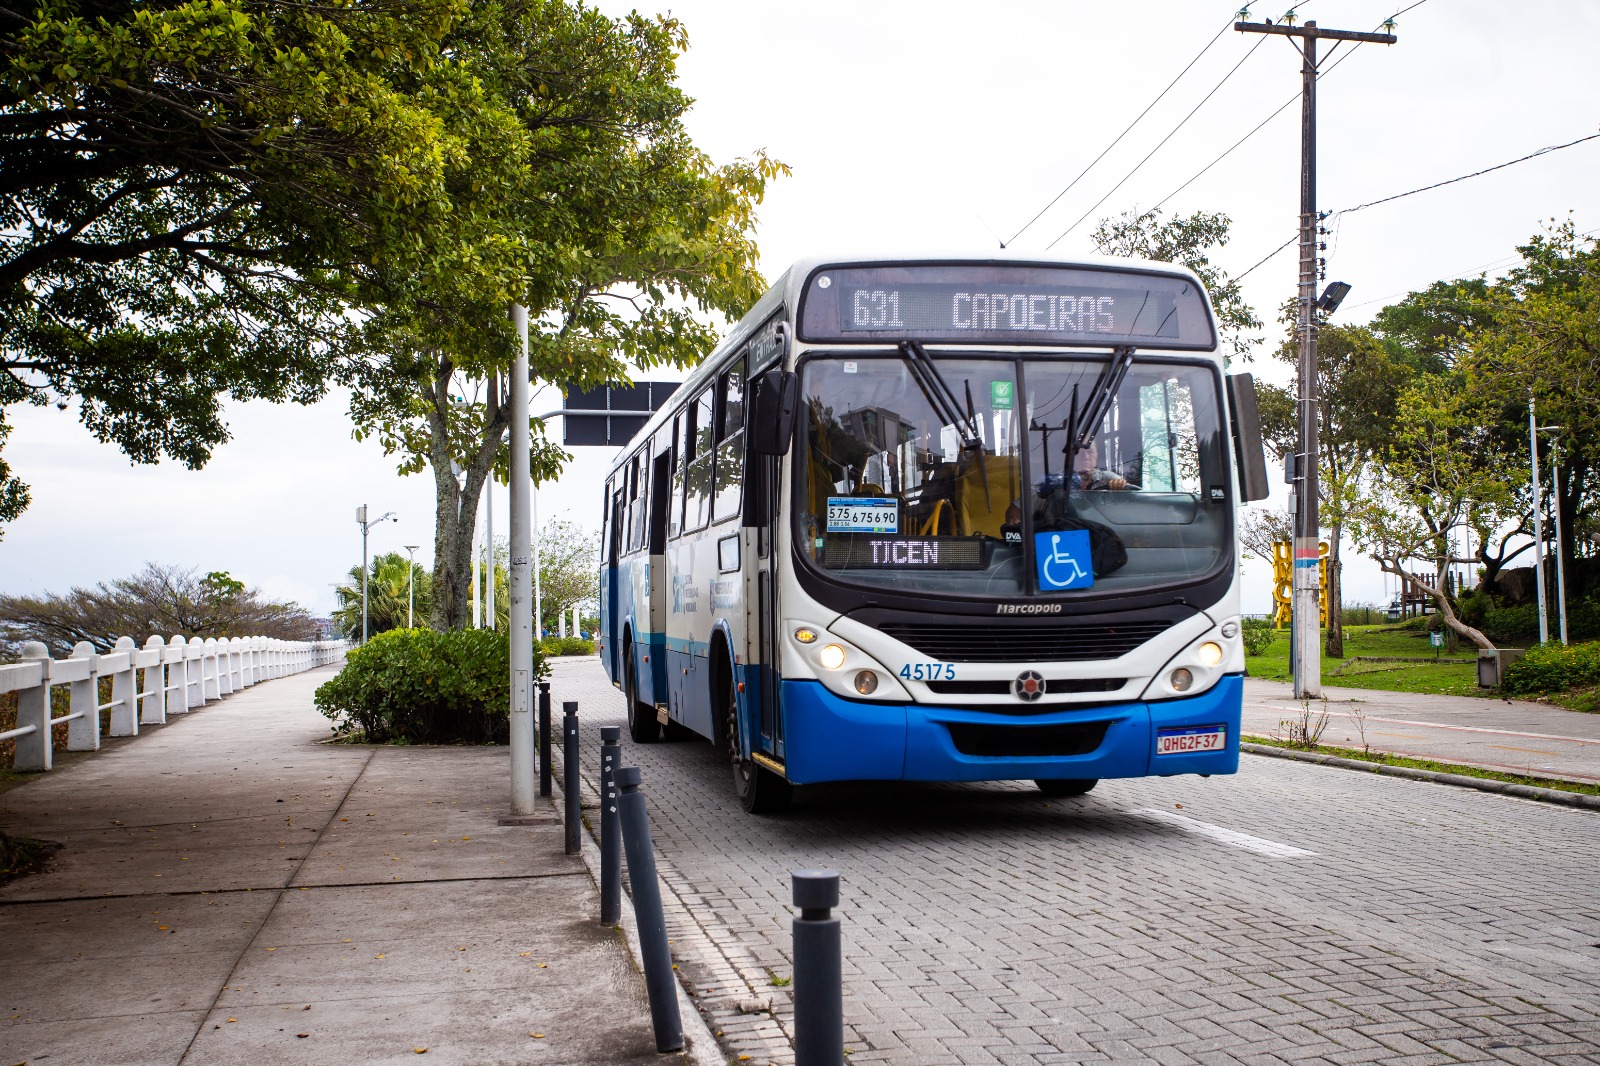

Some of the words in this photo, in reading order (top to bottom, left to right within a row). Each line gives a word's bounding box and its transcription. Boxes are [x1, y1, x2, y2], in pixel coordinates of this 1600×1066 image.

[854, 290, 903, 327] 631
[953, 292, 1114, 332] CAPOEIRAS
[869, 541, 939, 564] TICEN
[996, 603, 1062, 615] Marcopolo
[899, 663, 956, 681] 45175
[1163, 734, 1219, 751] QHG2F37
